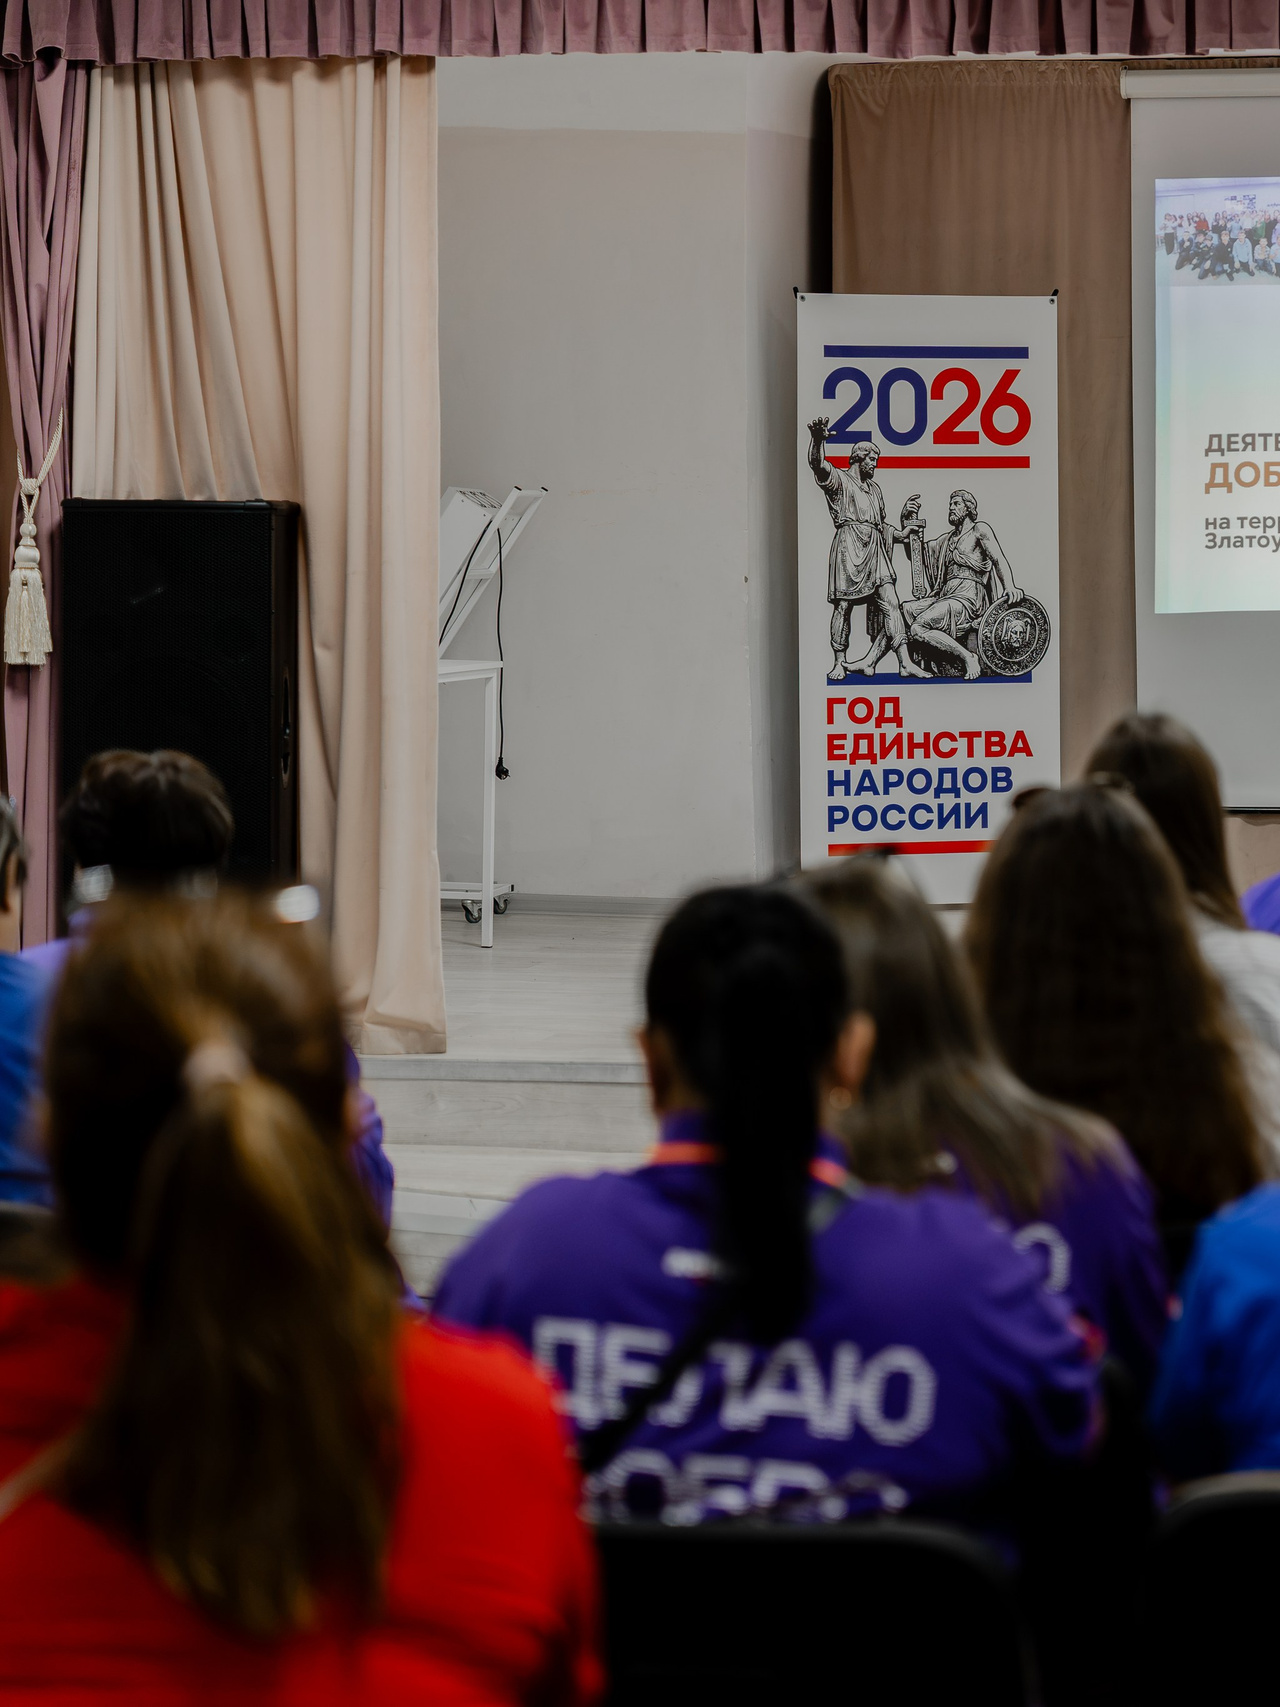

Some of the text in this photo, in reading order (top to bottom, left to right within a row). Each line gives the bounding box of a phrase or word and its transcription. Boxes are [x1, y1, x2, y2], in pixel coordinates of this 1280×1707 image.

[822, 366, 1032, 446] 2026
[1204, 515, 1231, 530] на
[826, 697, 904, 730] ГОД
[826, 730, 1034, 766] ЕДИНСТВА
[827, 766, 1014, 798] НАРОДОВ
[827, 802, 989, 833] РОССИИ
